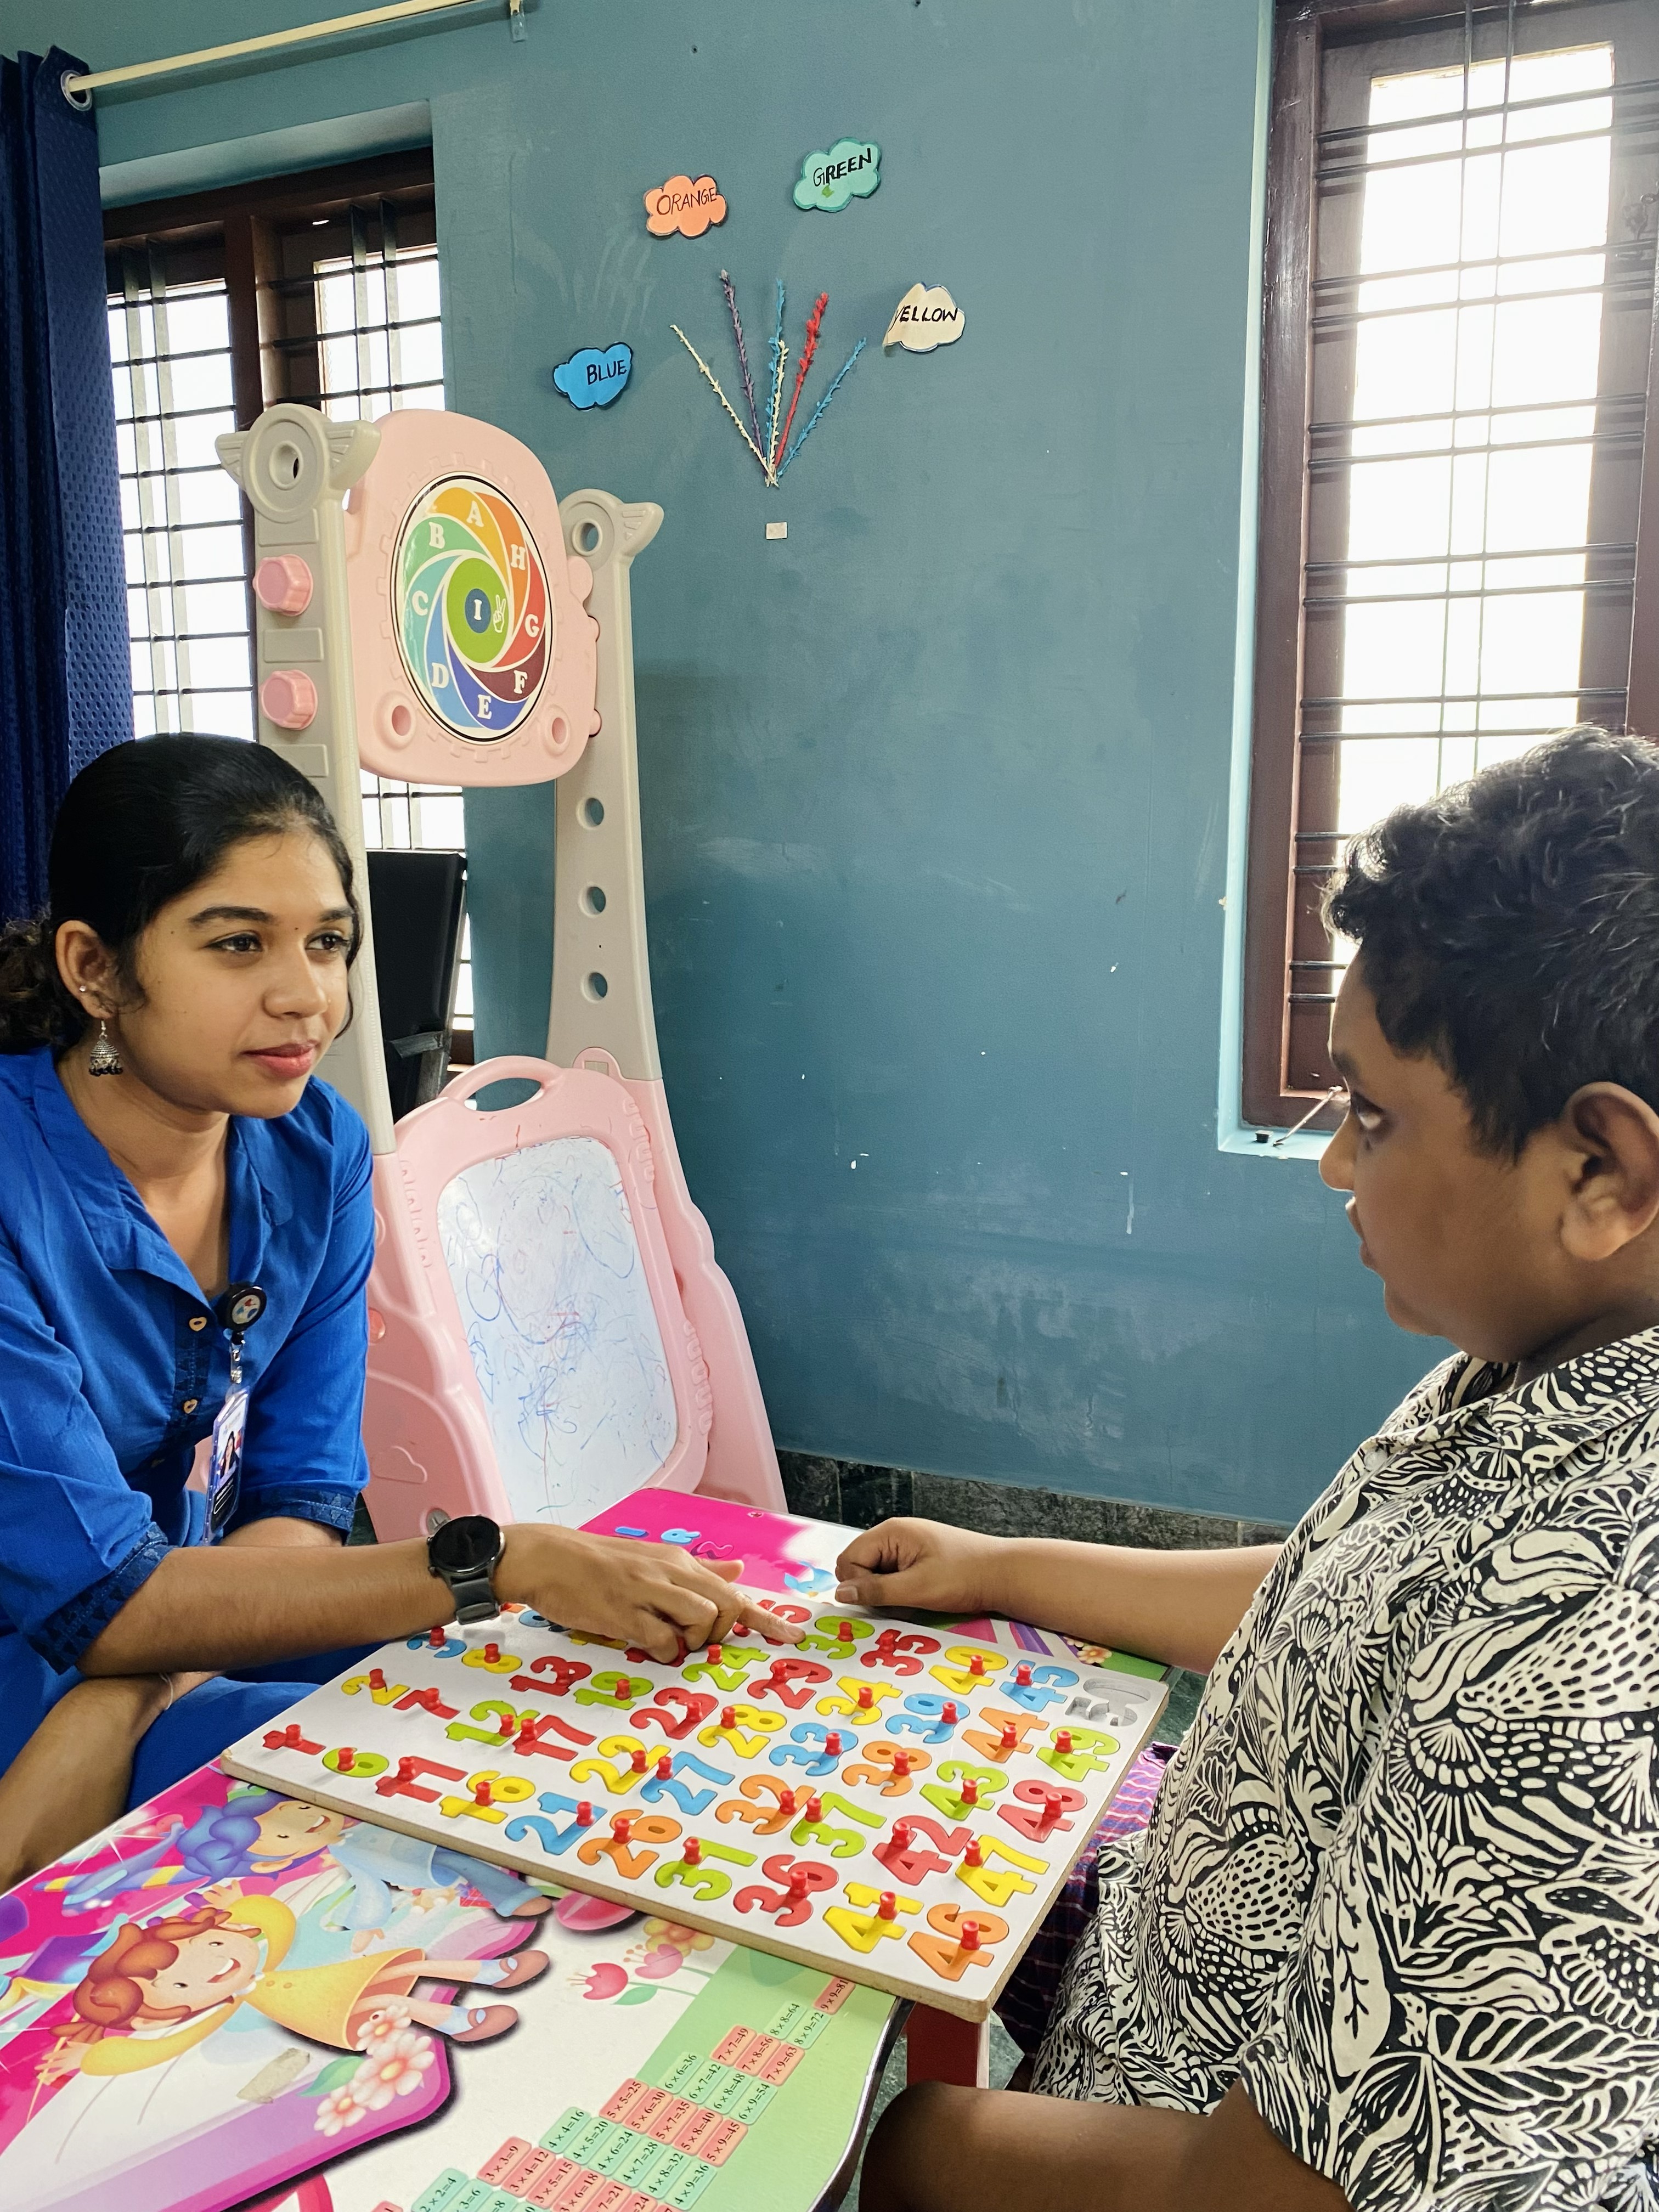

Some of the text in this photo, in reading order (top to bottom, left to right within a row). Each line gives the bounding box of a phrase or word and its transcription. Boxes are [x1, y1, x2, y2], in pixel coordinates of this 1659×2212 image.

[814, 148, 872, 185] GREEN
[657, 187, 718, 216] ORANGE
[586, 359, 628, 385] BLUE
[466, 500, 484, 527] A
[428, 521, 445, 549] B
[510, 544, 526, 571] H
[412, 590, 428, 616] C
[473, 599, 483, 621] I
[524, 614, 540, 637] G
[431, 663, 449, 689] D
[513, 670, 528, 695] F
[477, 694, 492, 720] E
[407, 1633, 466, 1658] 3
[795, 1616, 874, 1659] 30
[861, 1629, 941, 1676] 35
[462, 1649, 522, 1673] 8
[509, 1656, 592, 1696] 13
[682, 1644, 770, 1691] 24
[928, 1646, 1008, 1695] 40
[341, 1675, 410, 1706] 2
[573, 1672, 654, 1710] 18
[747, 1658, 832, 1708] 29
[816, 1675, 902, 1725] 34
[999, 1660, 1079, 1712] 45
[393, 1690, 460, 1719] 7
[445, 1700, 540, 1746] 12
[630, 1688, 718, 1740] 23
[885, 1694, 970, 1743] 39
[263, 1730, 326, 1755] 1
[512, 1715, 596, 1760] 17
[698, 1704, 787, 1759] 28
[769, 1723, 859, 1776] 33
[962, 1707, 1048, 1764] 44
[323, 1747, 389, 1778] 6
[569, 1736, 671, 1795] 22
[841, 1741, 932, 1797] 38
[1036, 1726, 1120, 1782] 49
[376, 1756, 467, 1803] 11
[439, 1771, 535, 1824] 16
[641, 1752, 735, 1815] 27
[919, 1760, 1008, 1821] 43
[505, 1792, 607, 1855] 21
[714, 1774, 816, 1835] 32
[997, 1780, 1087, 1843] 48
[577, 1810, 682, 1878] 26
[791, 1792, 887, 1858] 37
[654, 1839, 758, 1901] 31
[872, 1815, 974, 1886] 42
[733, 1854, 839, 1926] 36
[955, 1835, 1051, 1908] 47
[822, 1881, 925, 1954] 41
[907, 1903, 1009, 1982] 46
[829, 1979, 849, 1997] 9=81
[780, 2003, 800, 2023] 8=64
[803, 2012, 824, 2032] 9=72
[727, 2028, 749, 2048] 7=49
[752, 2038, 774, 2058] 8=56
[776, 2046, 797, 2068] 9=63
[676, 2053, 697, 2075] 6=36
[698, 2063, 721, 2085] 7=42
[607, 2111, 617, 2119] 5
[619, 2081, 642, 2104] 5=25
[723, 2073, 746, 2096] 8=48
[748, 2083, 770, 2106] 9=54
[561, 2110, 584, 2134] 4=16
[630, 2121, 641, 2129] 5
[644, 2091, 666, 2114] 6=30
[655, 2131, 666, 2140] 5
[667, 2101, 690, 2124] 7=35
[584, 2120, 608, 2145] 5=20
[610, 2131, 634, 2155] 6=24
[680, 2142, 691, 2151] 5
[692, 2112, 715, 2135] 8=40
[706, 2153, 716, 2162] 5
[717, 2122, 740, 2146] 9=45
[485, 2172, 495, 2181] 3
[499, 2146, 518, 2165] 3=9
[510, 2183, 520, 2192] 3
[524, 2151, 549, 2175] 4=12
[623, 2174, 633, 2182] 4
[634, 2142, 658, 2166] 7=28
[648, 2185, 658, 2193] 4
[659, 2153, 683, 2177] 8=32
[435, 2177, 457, 2197] 2=4
[534, 2195, 545, 2204] 3
[548, 2162, 573, 2187] 5=15
[574, 2173, 599, 2198] 6=18
[674, 2197, 685, 2205] 4
[685, 2165, 709, 2188] 9=36
